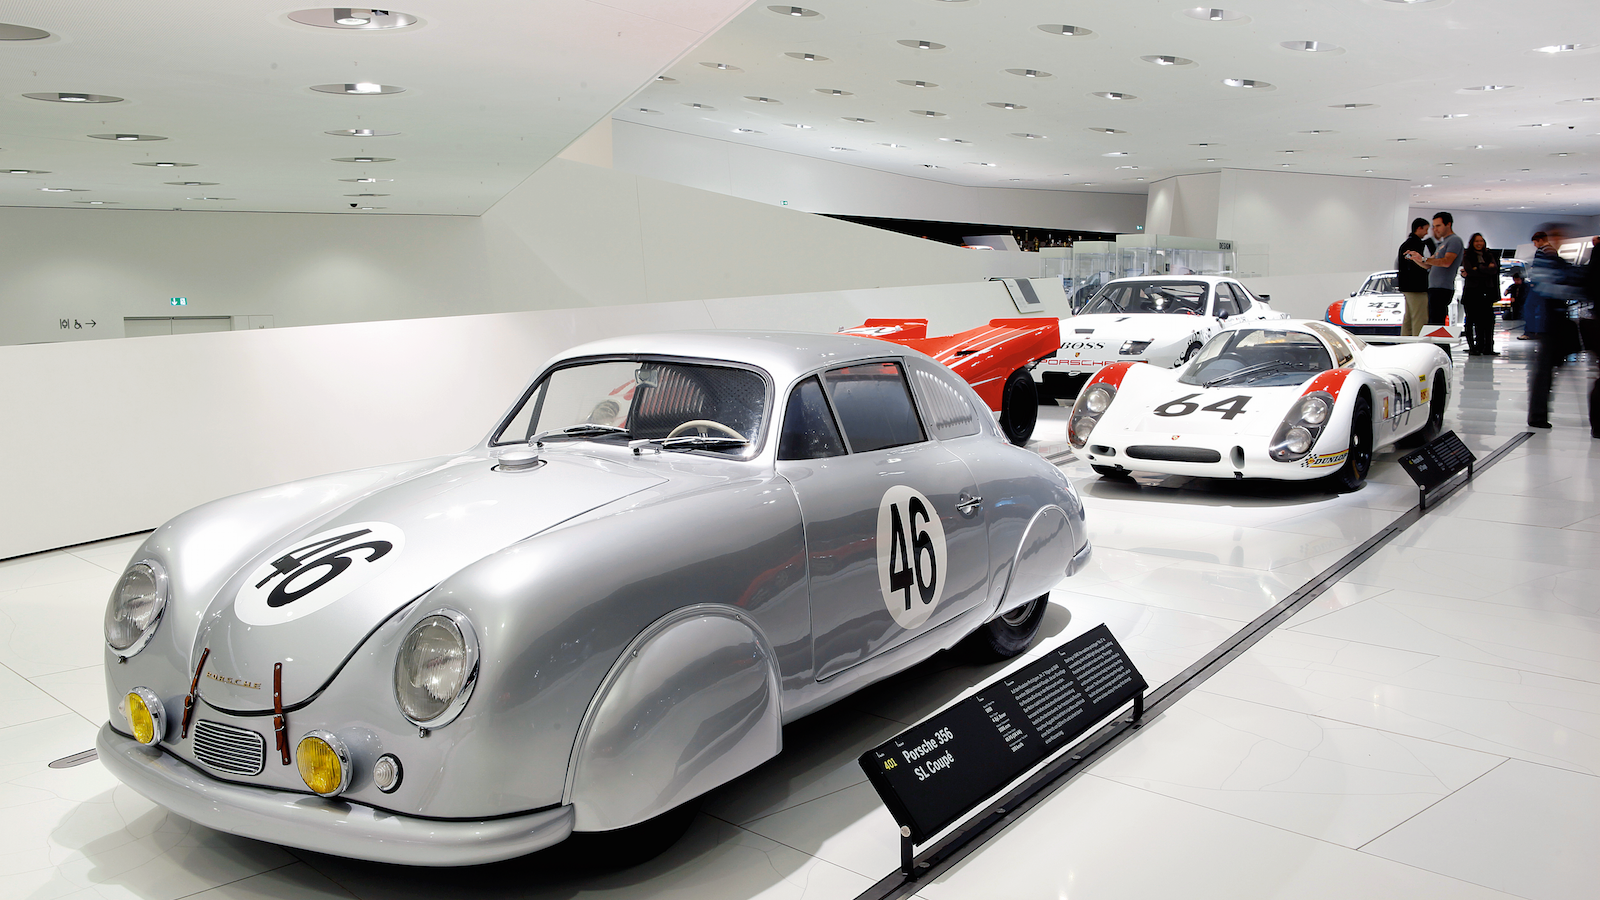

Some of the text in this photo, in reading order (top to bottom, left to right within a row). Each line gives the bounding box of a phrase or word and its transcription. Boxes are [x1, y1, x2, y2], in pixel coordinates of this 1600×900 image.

[1219, 242, 1231, 250] DESIGN
[1061, 342, 1105, 350] BOSS
[1153, 393, 1253, 421] 64
[1314, 453, 1347, 465] DUNLOP
[889, 496, 937, 611] 46
[255, 528, 393, 608] 46
[902, 727, 954, 763] Porsche 356
[884, 757, 898, 770] 401
[914, 750, 955, 781] SL Coupé
